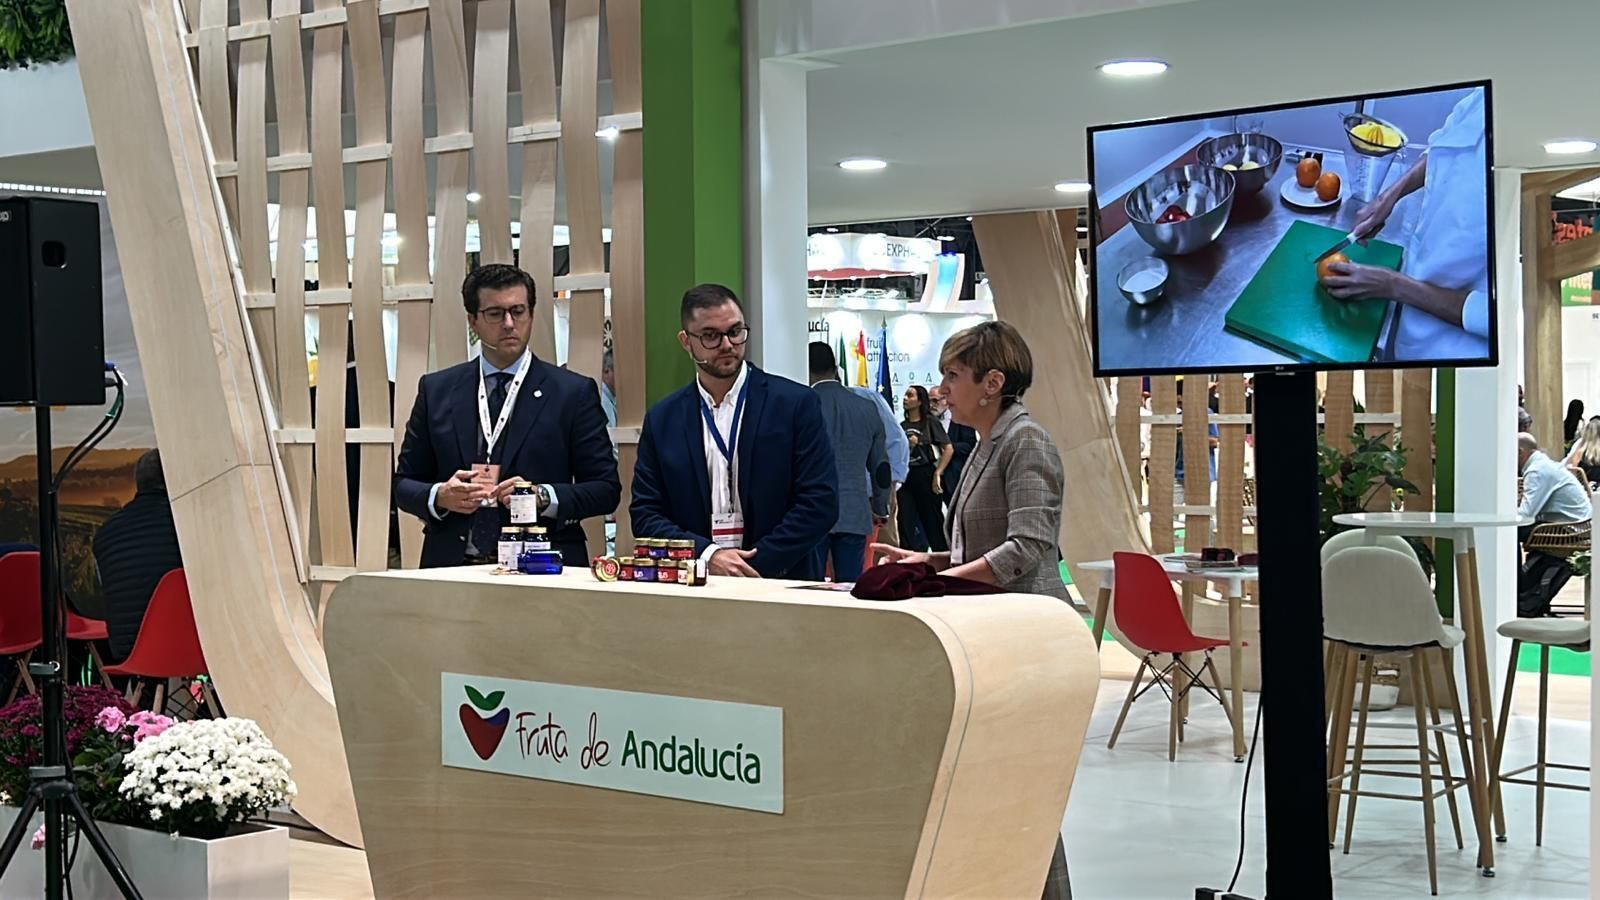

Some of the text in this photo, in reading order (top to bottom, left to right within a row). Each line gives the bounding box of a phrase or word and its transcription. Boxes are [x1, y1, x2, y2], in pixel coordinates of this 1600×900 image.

[866, 337, 883, 349] frui
[866, 351, 910, 362] attction
[515, 711, 761, 785] Fruta de Andalucía
